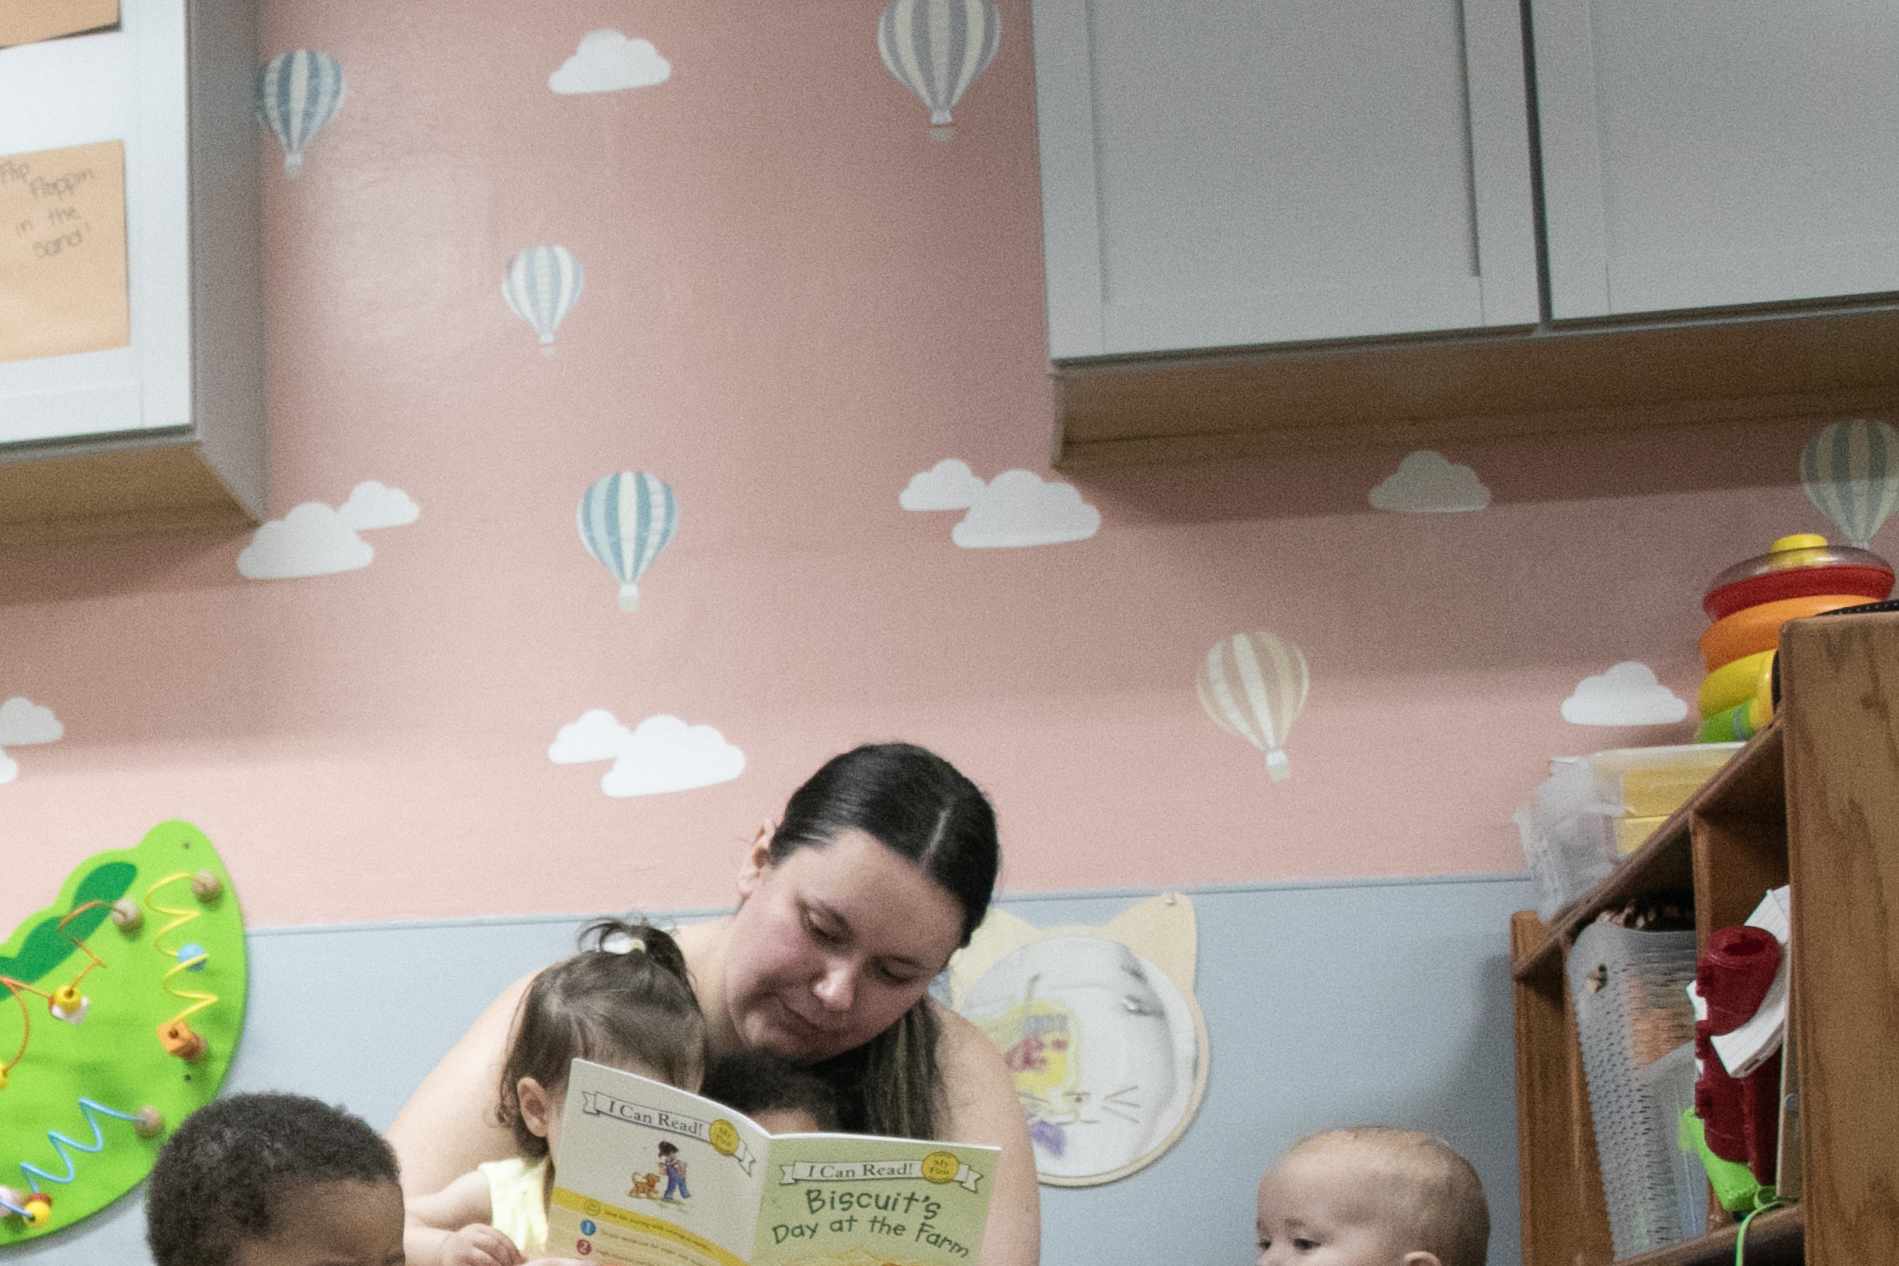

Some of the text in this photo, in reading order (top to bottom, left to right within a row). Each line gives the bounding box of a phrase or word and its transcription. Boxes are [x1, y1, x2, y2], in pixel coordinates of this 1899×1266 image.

[609, 1101, 703, 1136] I Can Read!
[807, 1163, 914, 1178] I Can Read!
[805, 1188, 942, 1221] Biscuit's
[772, 1215, 969, 1259] Day at the Farm
